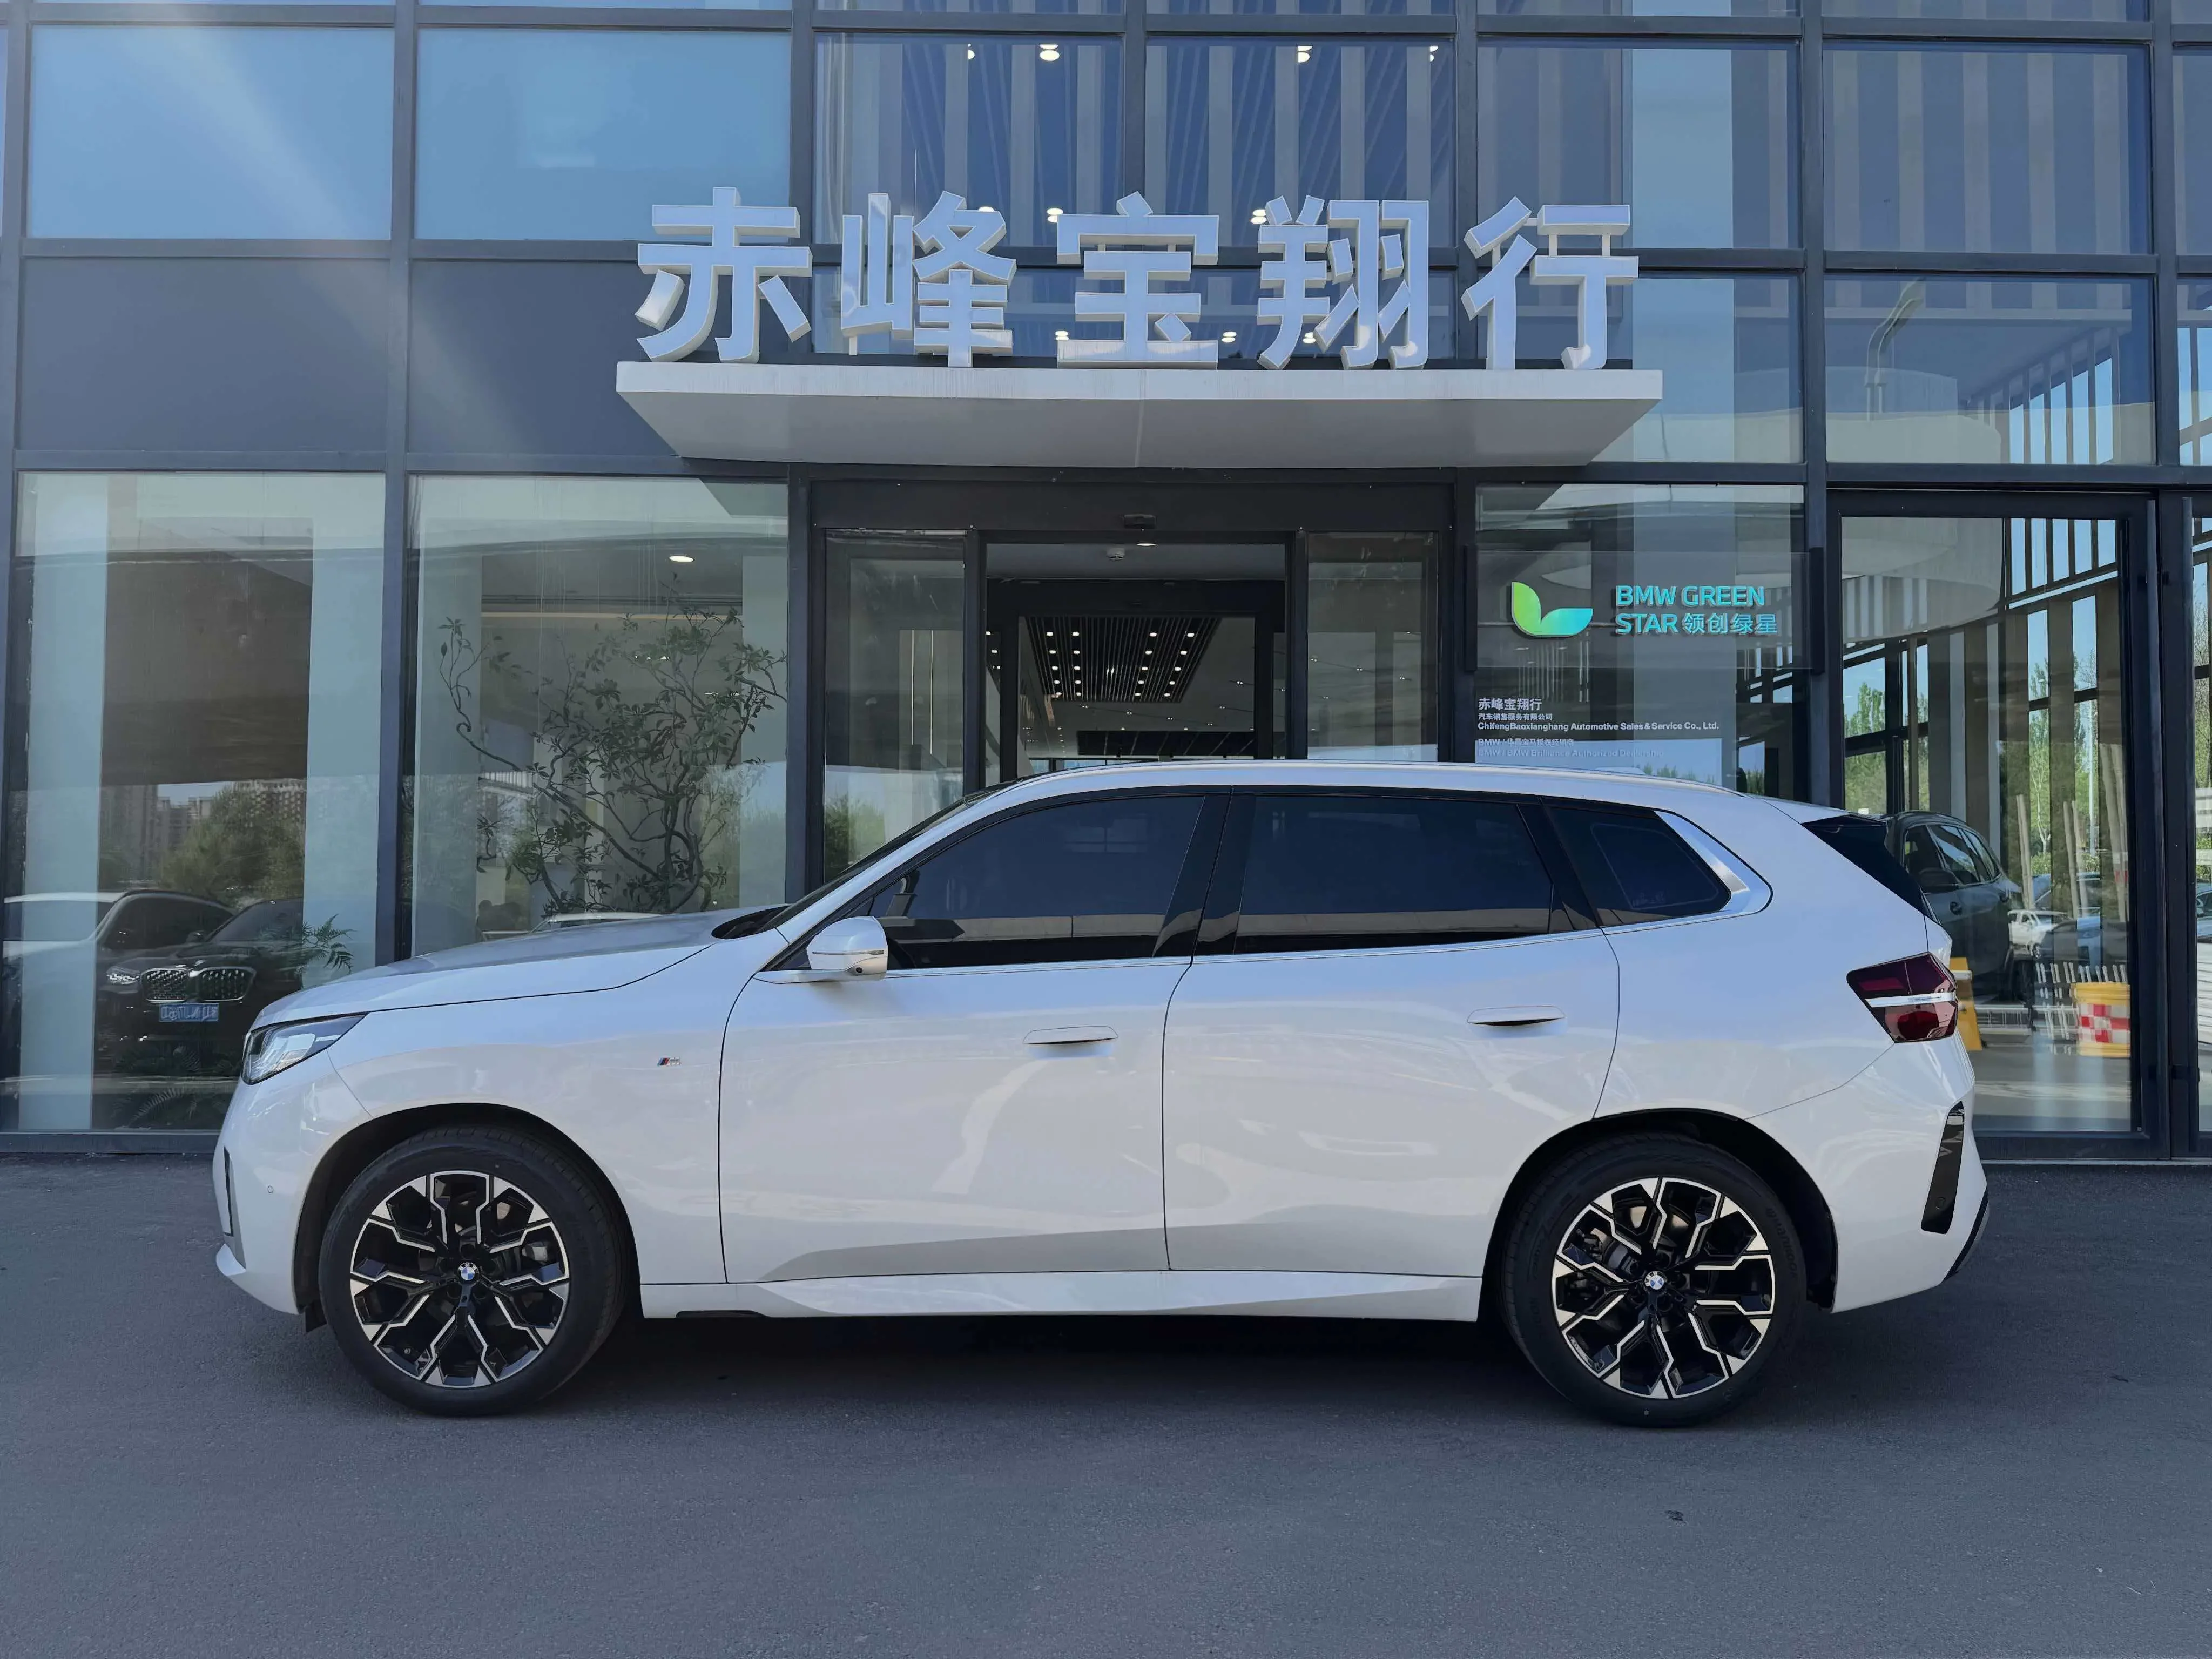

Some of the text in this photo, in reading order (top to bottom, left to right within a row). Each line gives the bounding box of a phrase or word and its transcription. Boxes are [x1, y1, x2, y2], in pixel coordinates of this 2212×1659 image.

[635, 187, 1639, 370] 赤峰宝翔行
[1615, 585, 1764, 606] BMW GREEN
[1615, 613, 1778, 635] STAR 领创绿星
[1478, 698, 1542, 711] 赤峰宝翔行
[1684, 721, 1701, 730] Co.,
[1703, 721, 1719, 730] Ltd.
